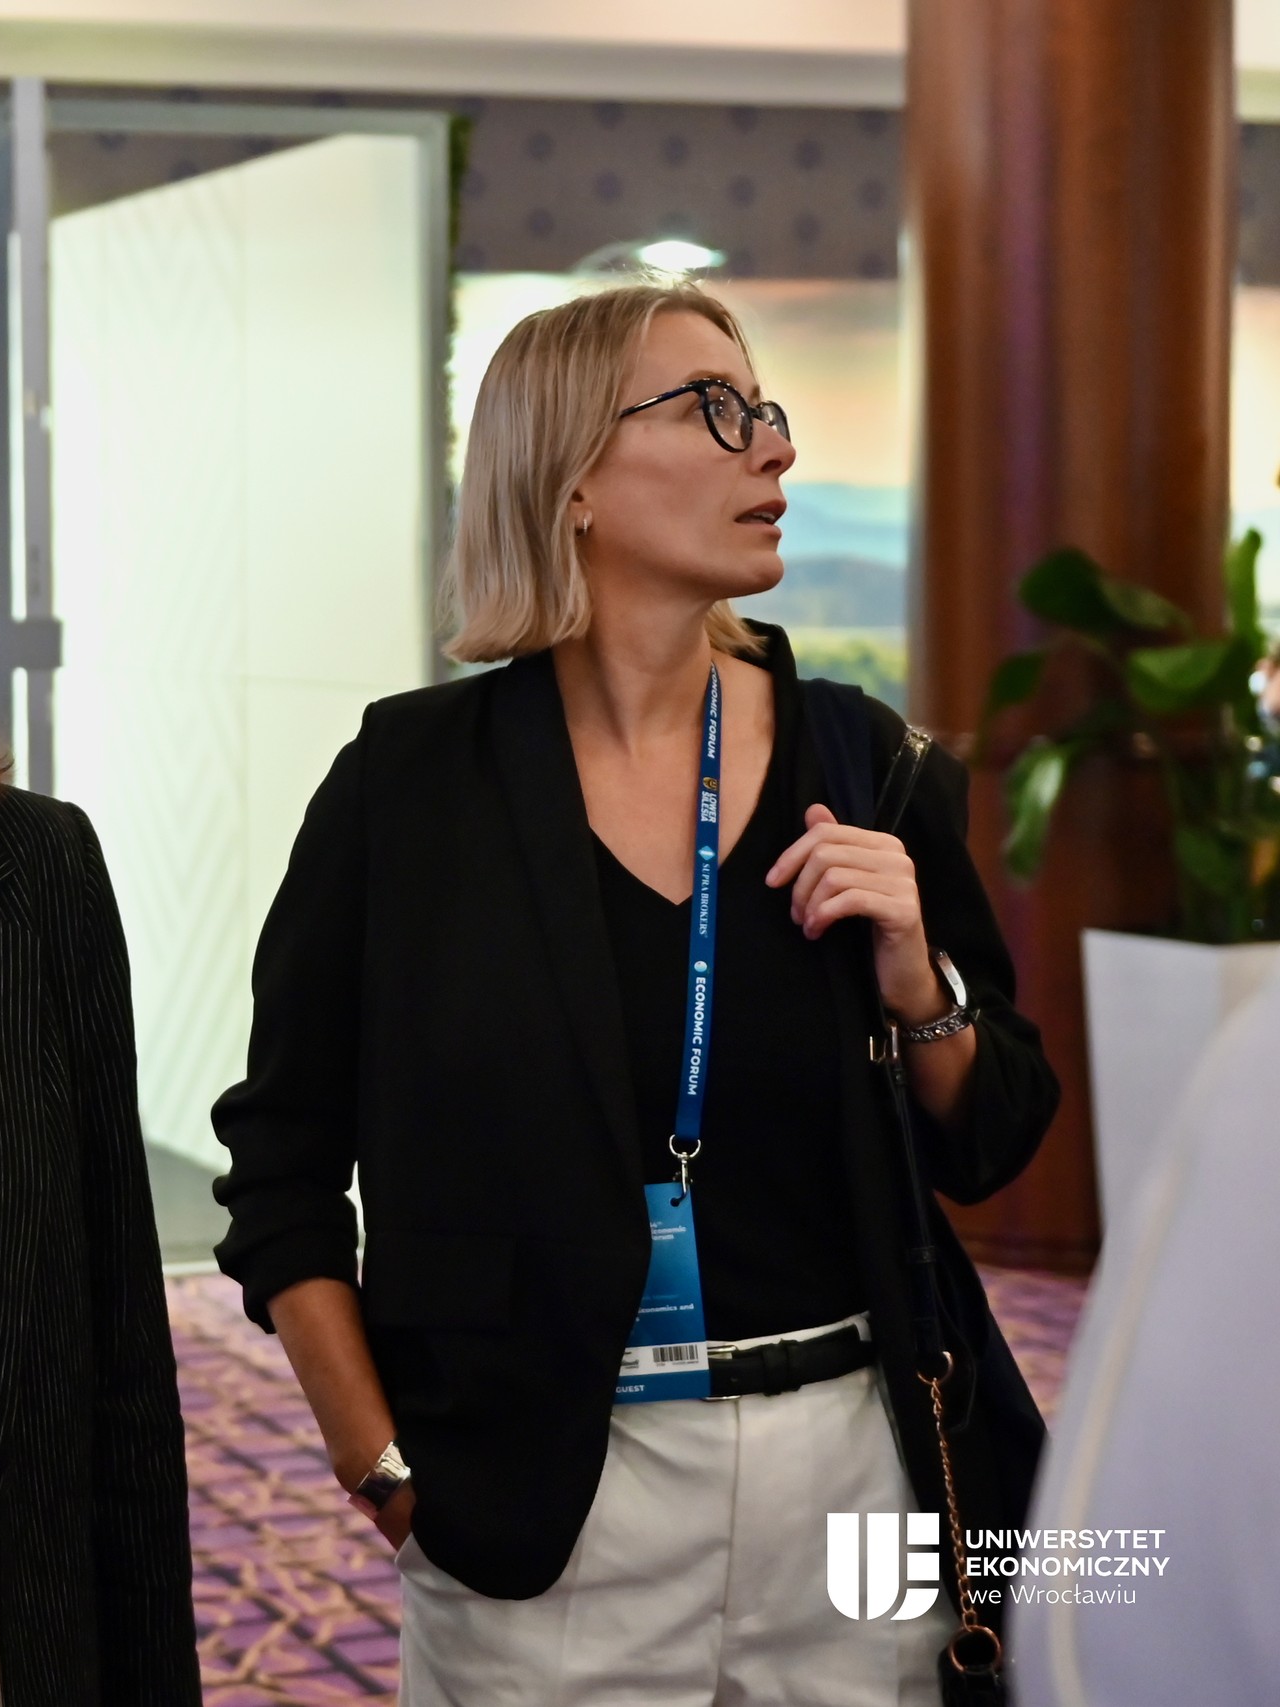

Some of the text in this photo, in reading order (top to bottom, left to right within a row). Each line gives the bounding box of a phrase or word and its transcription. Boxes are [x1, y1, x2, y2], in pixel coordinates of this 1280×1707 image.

[707, 718, 717, 759] FORUM
[707, 793, 717, 823] LOWER
[699, 863, 711, 935] SUPRA BROKERS
[687, 977, 706, 1096] ECONOMIC FORUM
[615, 1384, 645, 1393] GUEST
